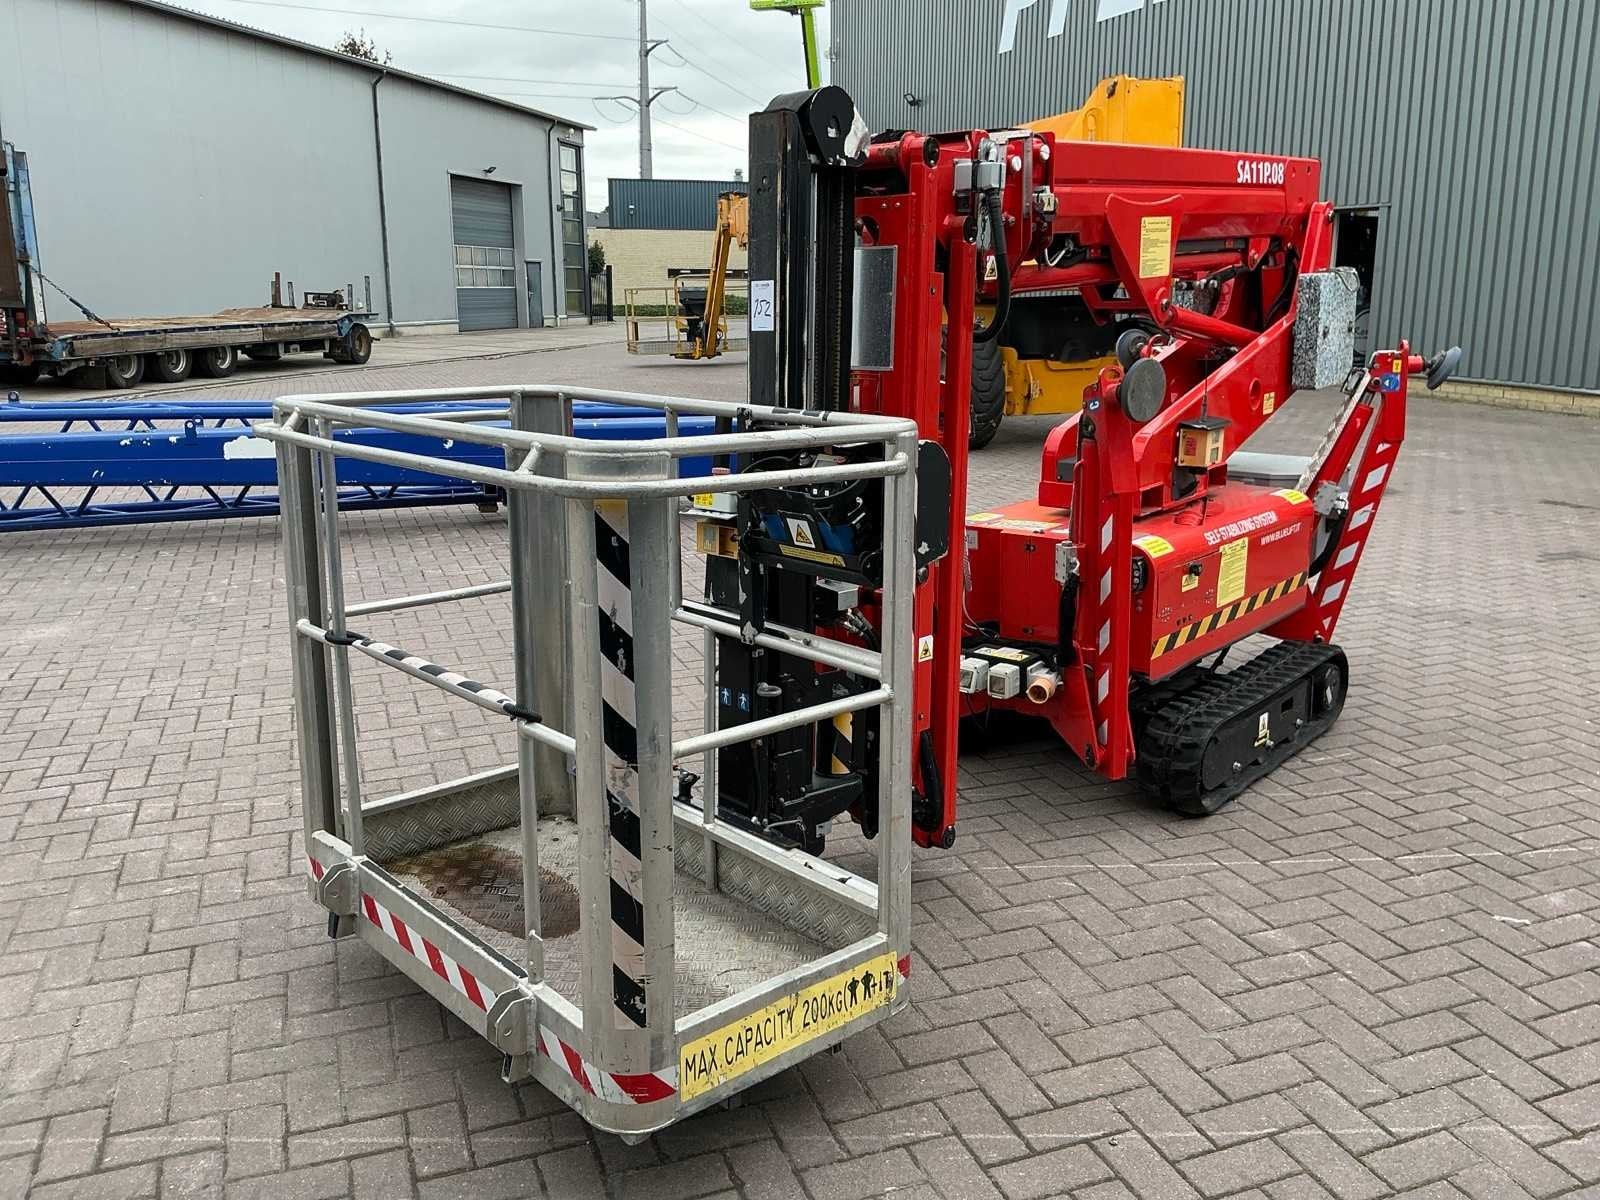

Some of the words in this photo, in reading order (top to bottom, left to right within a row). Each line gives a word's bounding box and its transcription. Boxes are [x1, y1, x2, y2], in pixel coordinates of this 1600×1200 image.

[1236, 159, 1285, 185] SA11P.08
[753, 298, 772, 319] 152
[724, 1003, 796, 1066] CAPACITY
